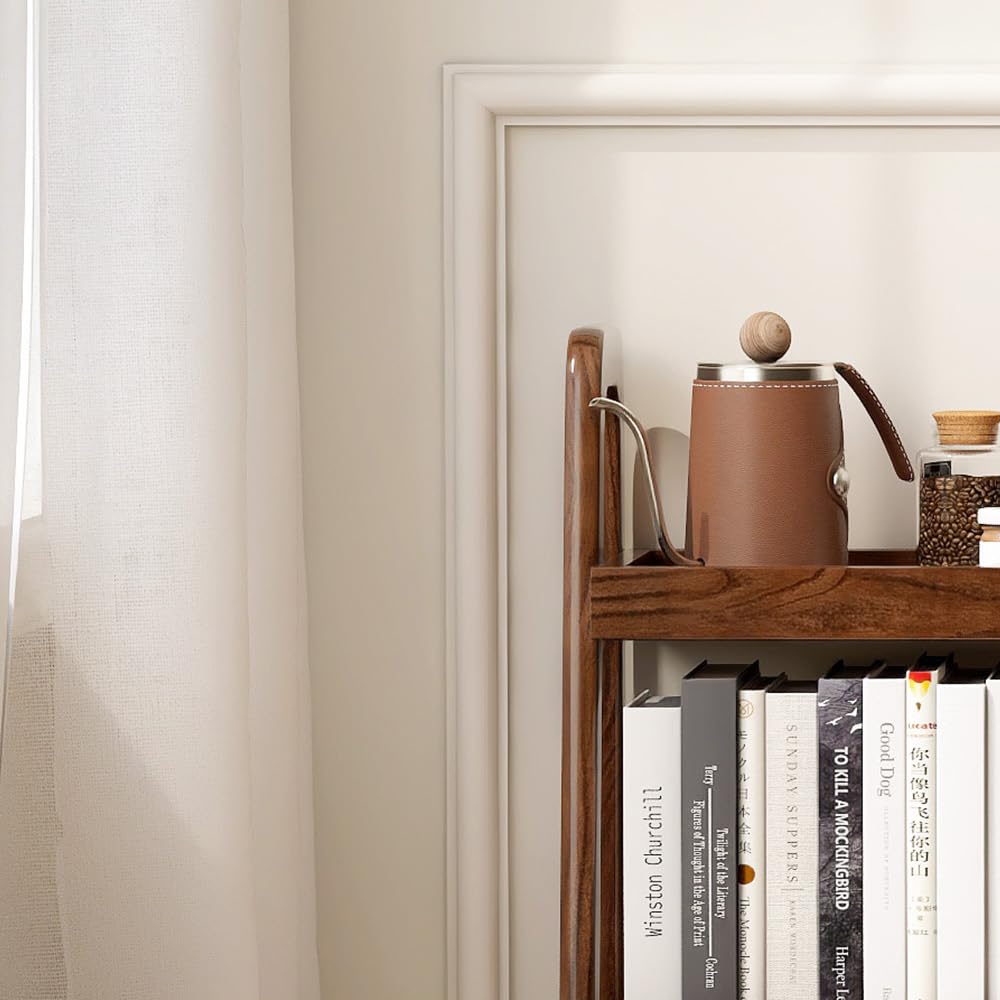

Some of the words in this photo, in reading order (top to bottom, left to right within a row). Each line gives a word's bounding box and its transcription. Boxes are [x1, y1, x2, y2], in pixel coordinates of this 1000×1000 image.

[834, 746, 849, 766] TO
[880, 722, 895, 762] Good
[786, 724, 798, 795] SUNDAY
[703, 765, 717, 786] Terry
[834, 769, 849, 796] KILL
[877, 766, 895, 798] Dog
[690, 800, 705, 830] Figures
[834, 800, 850, 810] A
[642, 786, 663, 866] Churchill
[693, 831, 705, 840] of
[690, 841, 705, 874] Thought
[714, 828, 728, 860] Twilight
[786, 805, 799, 883] SUPPERS
[716, 861, 728, 871] of
[834, 813, 850, 911] MOCKINGBIRD
[693, 874, 705, 884] in
[716, 872, 728, 884] the
[643, 875, 663, 938] Winston
[693, 886, 706, 899] the
[714, 886, 728, 918] Literary
[740, 897, 750, 916] The
[691, 900, 705, 915] Age
[694, 916, 705, 925] of
[693, 926, 706, 947] Print
[739, 916, 751, 964] Monocle
[705, 958, 718, 988] Cochran
[740, 966, 750, 993] Book
[832, 946, 849, 987] Harper
